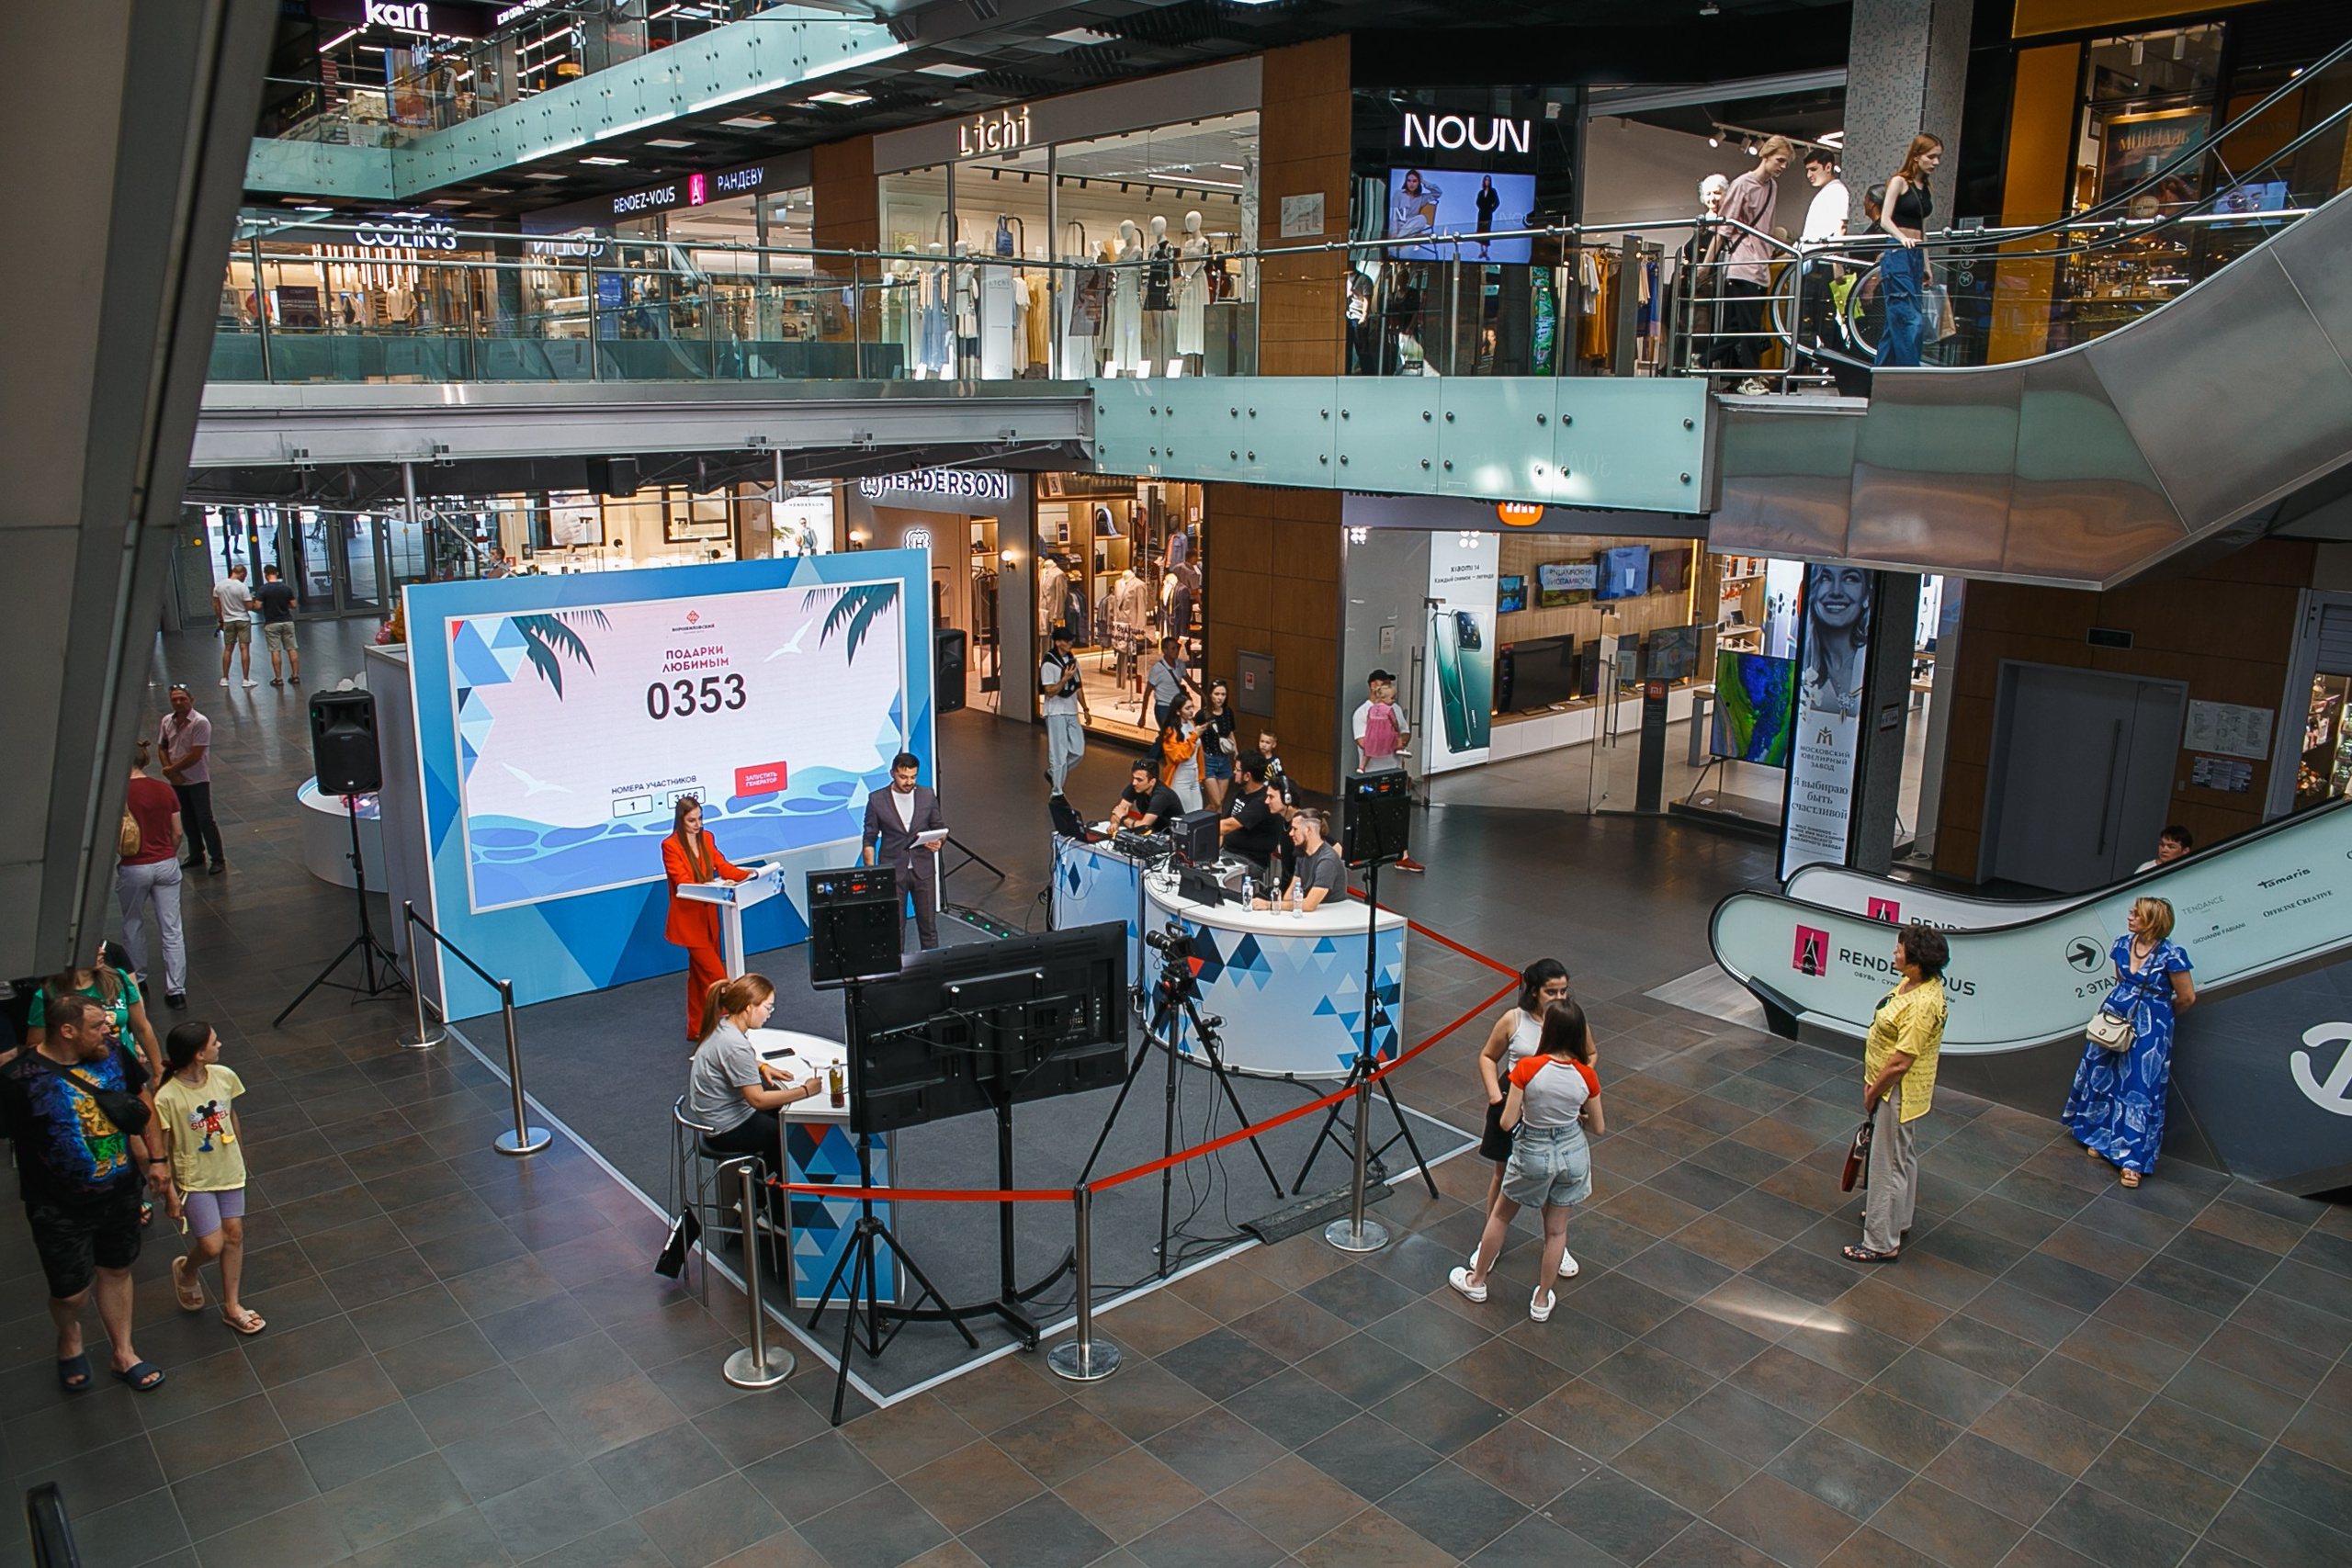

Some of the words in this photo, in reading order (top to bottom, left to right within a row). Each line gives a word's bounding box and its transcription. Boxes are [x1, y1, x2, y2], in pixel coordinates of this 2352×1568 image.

[365, 0, 429, 30] kari
[958, 106, 1030, 156] Lichi
[1404, 113, 1530, 153] NOUN
[718, 167, 764, 192] РАНДЕВУ
[614, 186, 675, 214] RENDEZ-VOUS
[355, 222, 458, 251] COLIN'S
[882, 468, 1009, 500] HENDERSON
[1434, 576, 1454, 584] Каждый
[666, 645, 724, 660] ПОДАРКИ
[662, 657, 729, 673] ЛЮБИМЫМ
[647, 672, 747, 720] 0353
[1800, 745, 1850, 759] МОСКОВСКИЙ
[1801, 753, 1848, 766] ЮВЕЛИРНЫЙ
[744, 771, 778, 781] ЗАПУСТИТЬ
[1810, 761, 1835, 773] ЗАВОД
[611, 783, 645, 795] НОМЕРА
[646, 774, 697, 790] УЧАСТНИКОВ
[745, 777, 778, 787] ГЕНЕРАТОР
[1792, 776, 1800, 786] Я
[1801, 780, 1849, 795] выбираю
[630, 802, 636, 811] 1
[1806, 792, 1834, 805] быть
[1791, 803, 1848, 820] счастливой
[2256, 868, 2311, 889] Tamaris
[2181, 895, 2226, 916] TENDANCE
[2192, 931, 2222, 945] GIOVANNI
[2222, 922, 2246, 935] FABIANI
[1854, 971, 1876, 982] ОБУВЬ
[2075, 987, 2086, 998] 2
